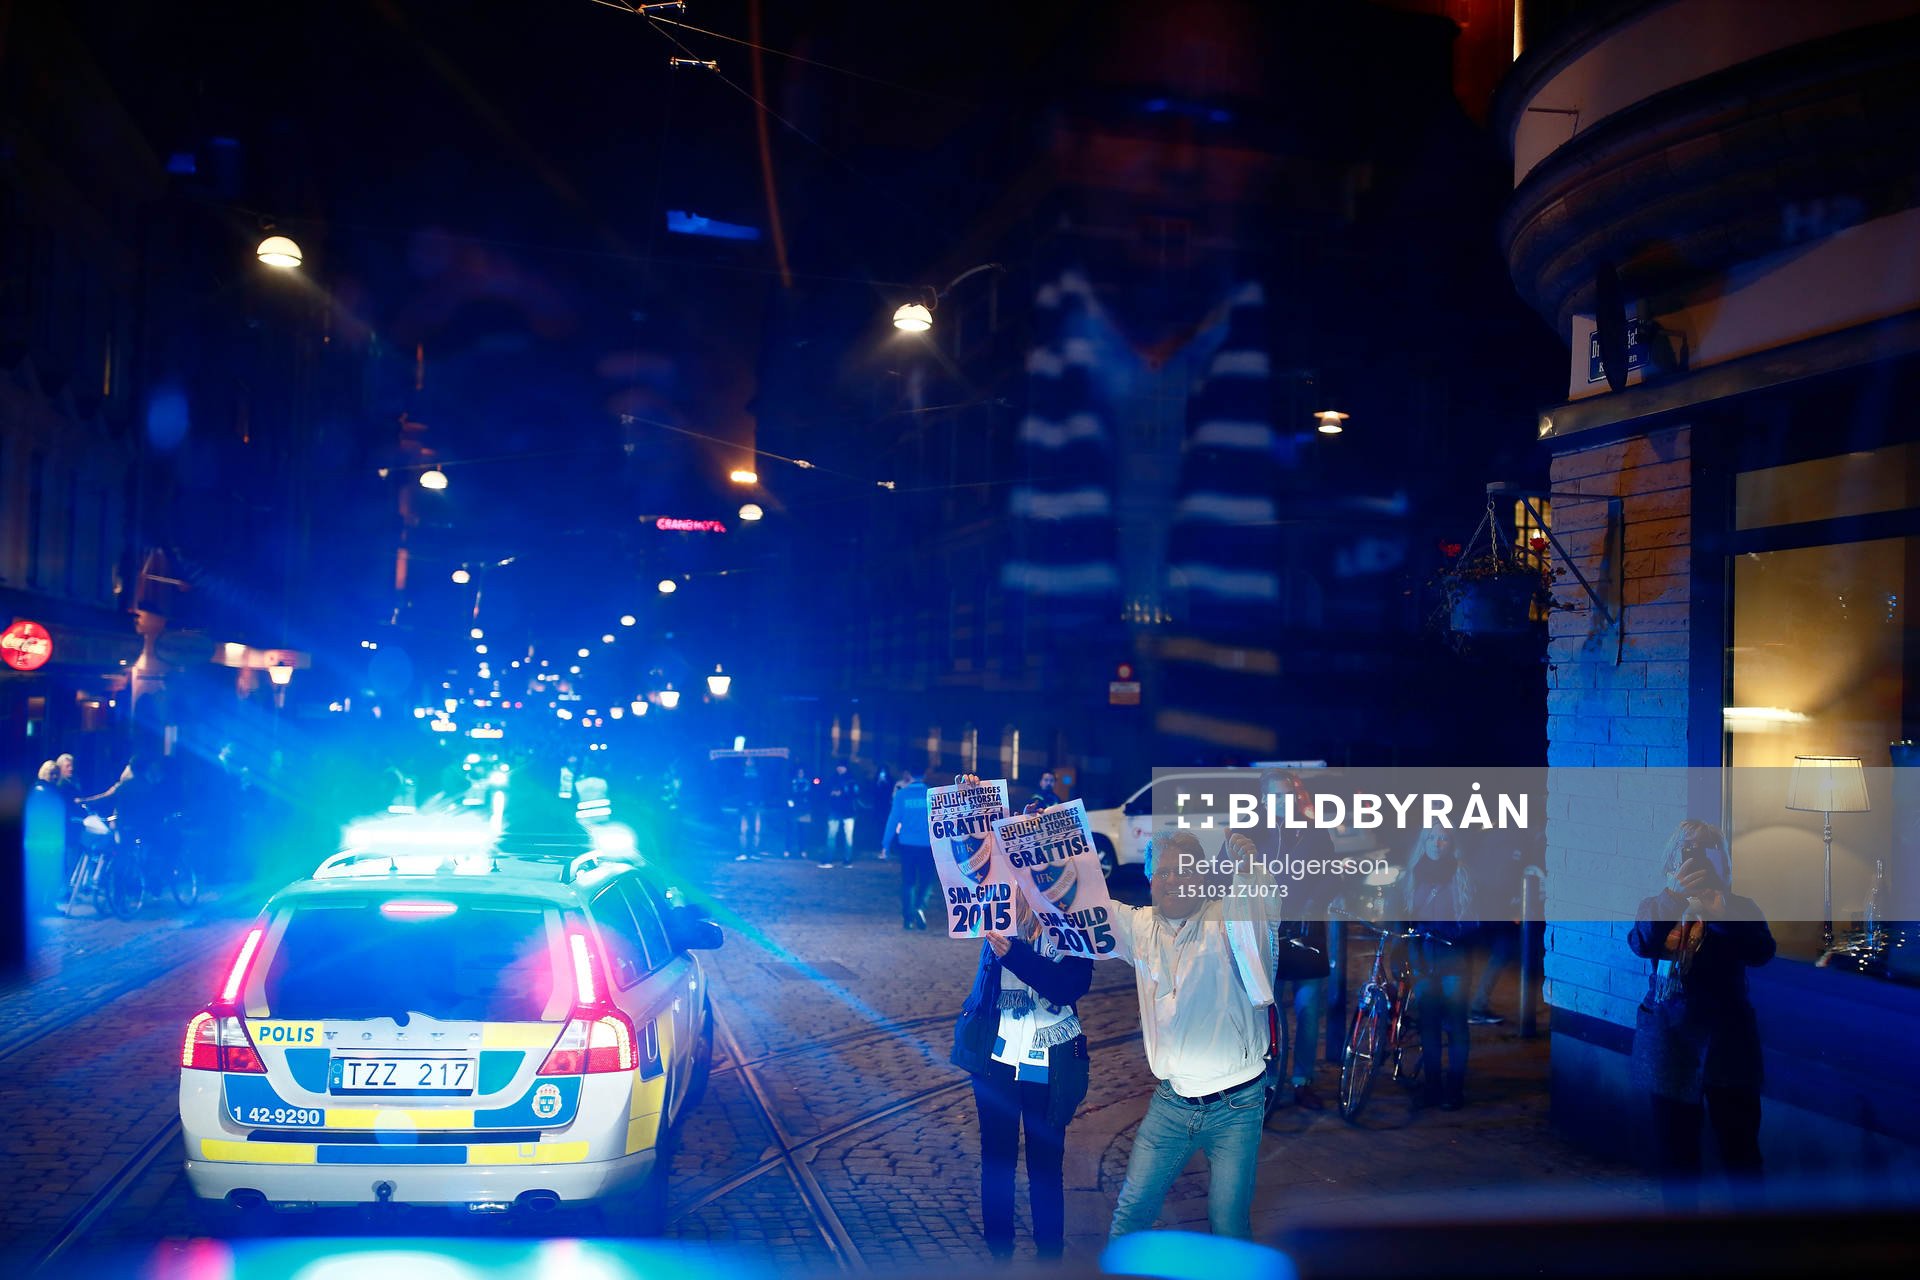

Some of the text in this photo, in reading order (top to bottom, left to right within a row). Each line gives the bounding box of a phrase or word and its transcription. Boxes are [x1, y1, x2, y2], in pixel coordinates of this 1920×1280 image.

[967, 785, 1001, 797] SVERIGES
[1043, 807, 1079, 823] SVERIGES
[999, 817, 1044, 841] SPORT
[1009, 833, 1090, 869] GRATTIS!
[949, 883, 1011, 905] SM-GULD
[952, 903, 1012, 933] 2015
[1038, 906, 1108, 930] SM-GULD
[1048, 923, 1116, 955] 2015
[259, 1026, 315, 1043] POLIS
[348, 1063, 469, 1087] TZZ 217
[233, 1106, 320, 1125] 1 42-9290
